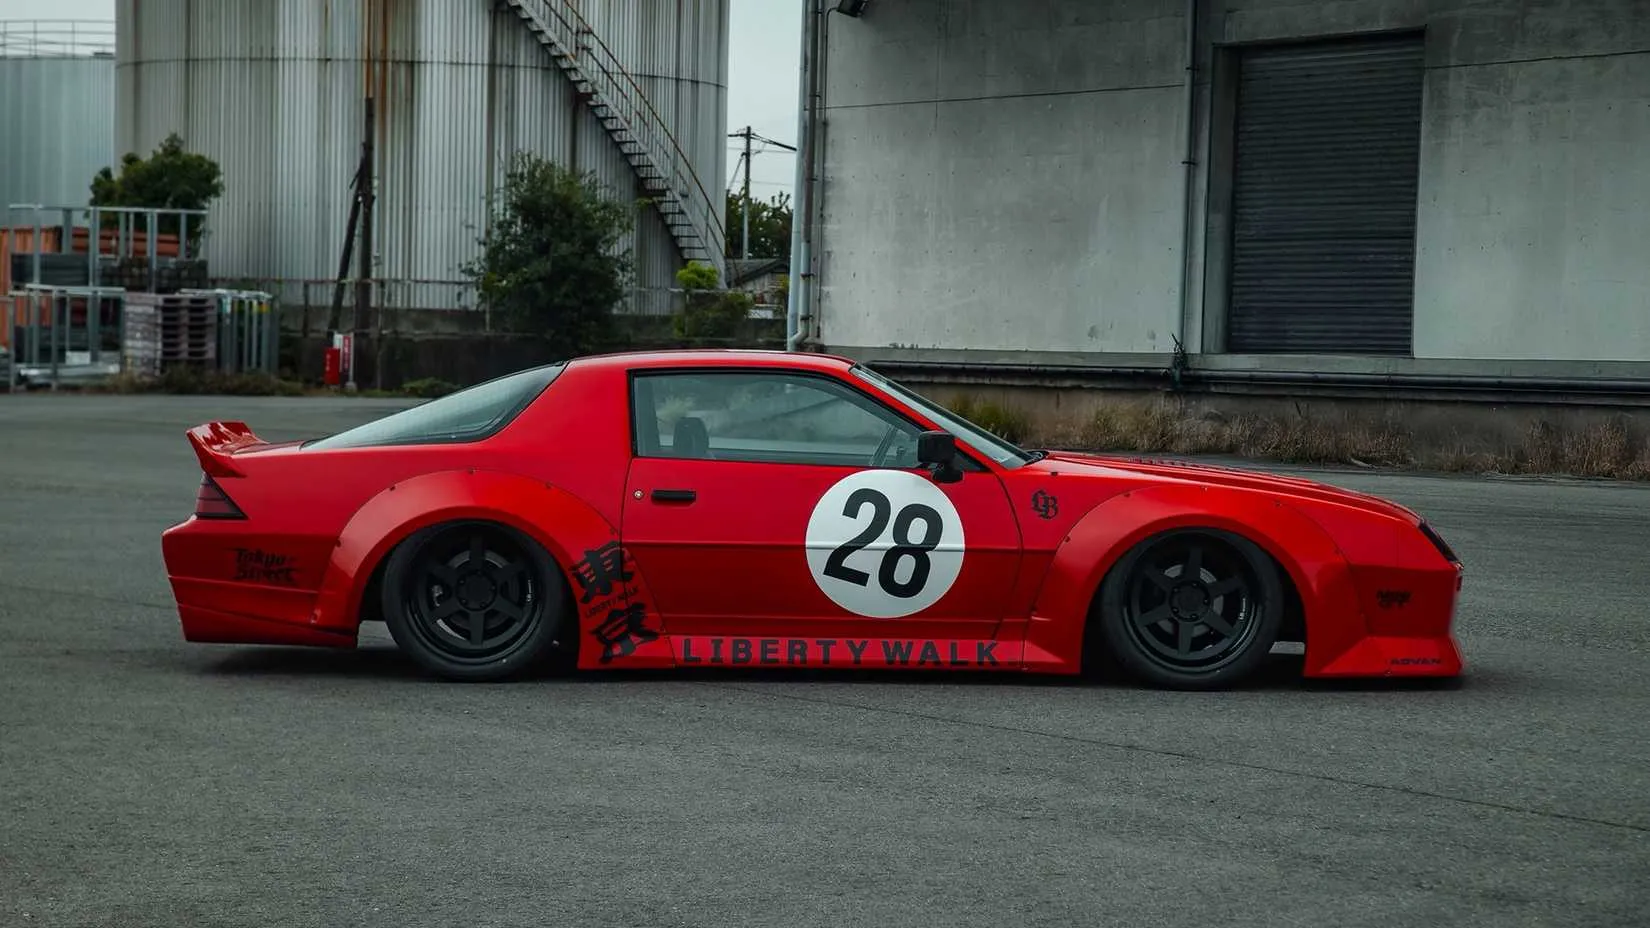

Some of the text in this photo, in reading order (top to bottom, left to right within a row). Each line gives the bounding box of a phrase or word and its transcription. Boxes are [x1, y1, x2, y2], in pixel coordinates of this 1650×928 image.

[823, 487, 943, 598] 28
[682, 638, 1001, 667] LIBERTY WALK
